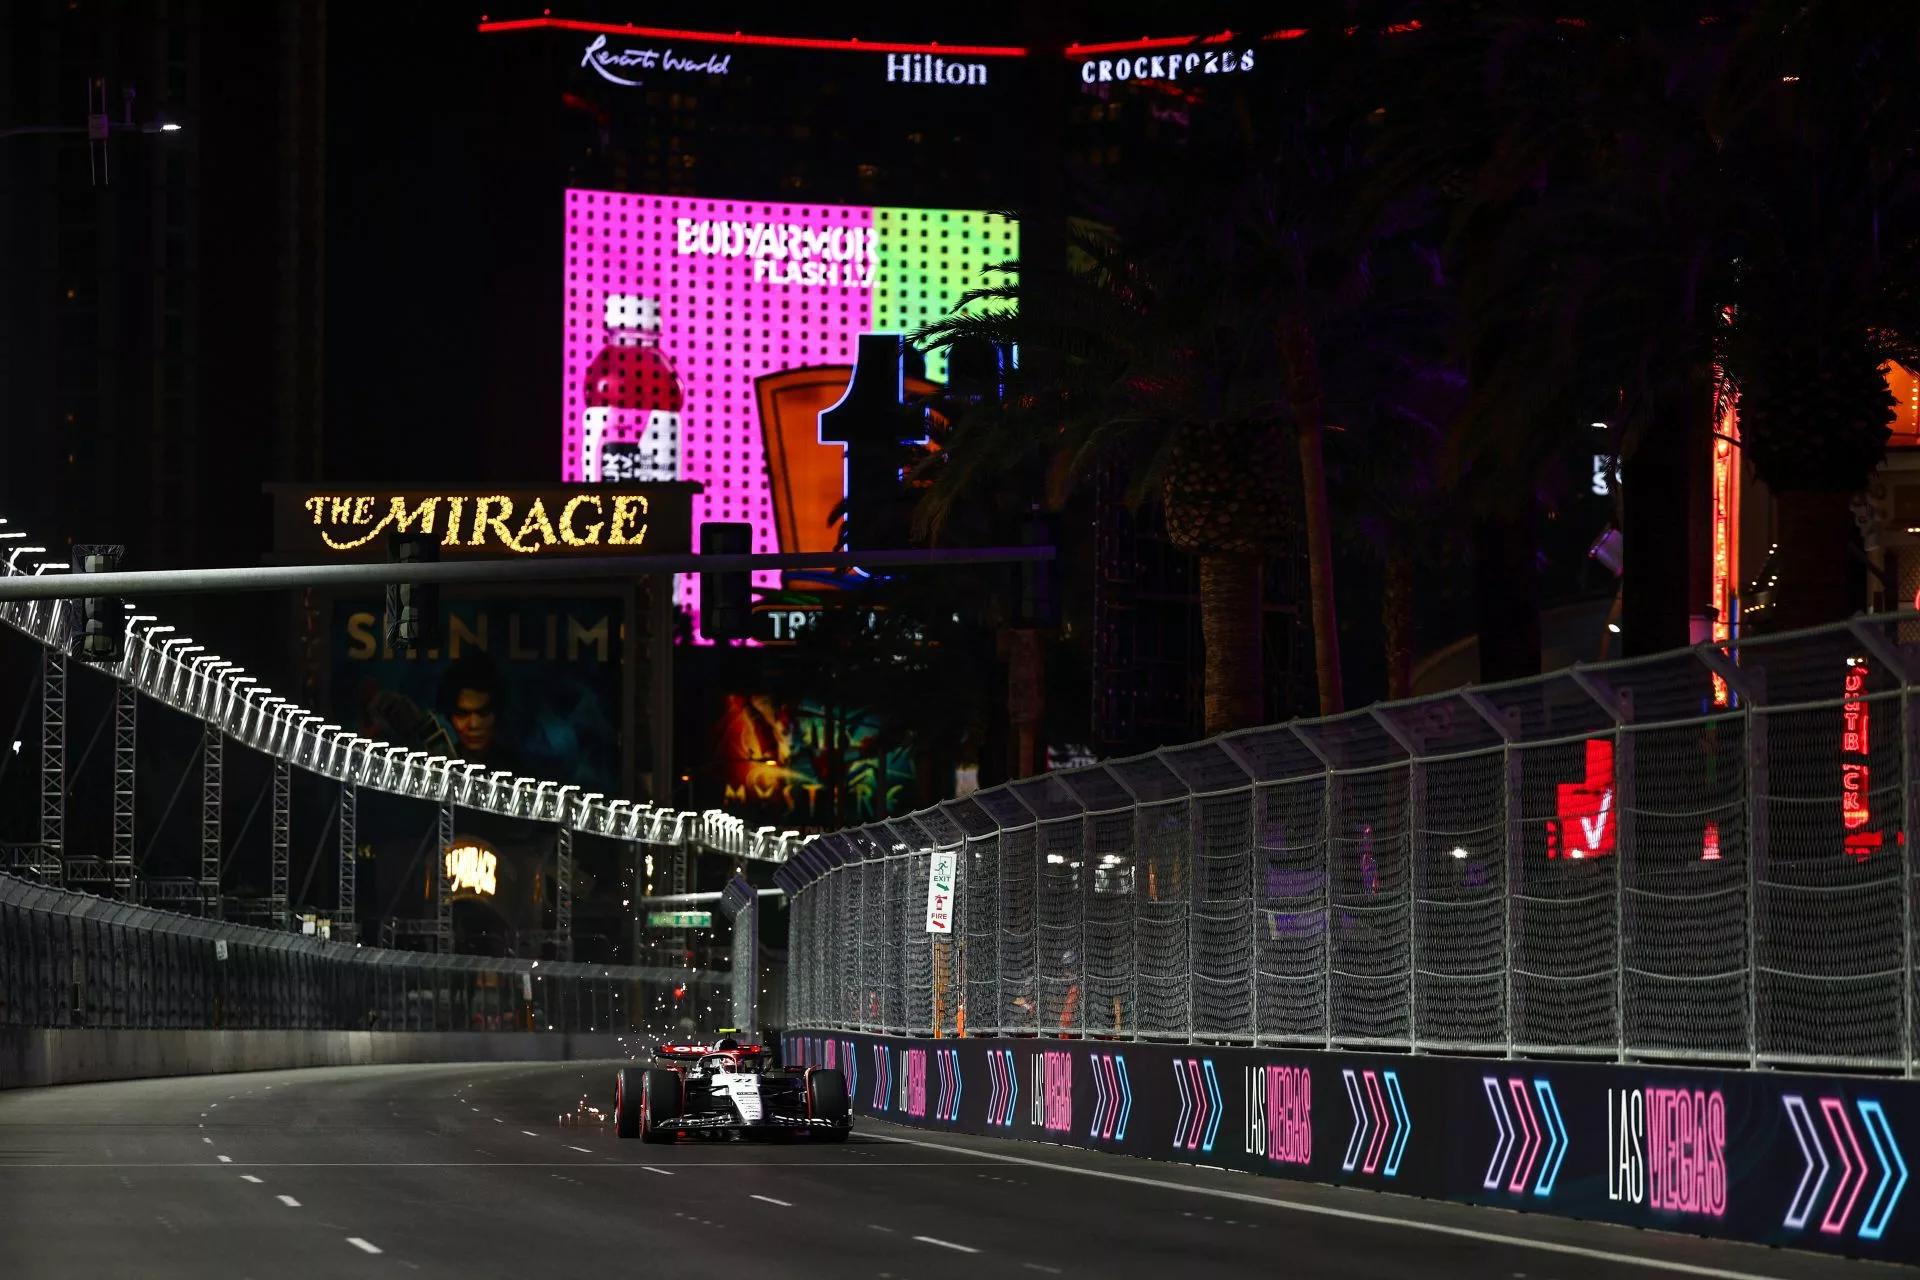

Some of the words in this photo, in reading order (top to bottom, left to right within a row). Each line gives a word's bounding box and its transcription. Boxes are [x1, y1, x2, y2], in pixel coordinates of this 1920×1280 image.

[581, 34, 660, 86] Resorts
[662, 49, 731, 74] World
[887, 53, 987, 85] Hilton
[677, 218, 880, 263] BODYARMOR
[754, 260, 838, 287] FLASH
[305, 496, 375, 524] THE
[322, 495, 648, 552] MIRAGE
[509, 612, 609, 662] LIM
[931, 912, 948, 920] FIRE
[1031, 1053, 1044, 1127] LAS
[1245, 1066, 1266, 1156] LAS
[1267, 1065, 1311, 1165] VEGAS
[1608, 1088, 1643, 1204] LAS
[1645, 1087, 1727, 1216] VEGAS
